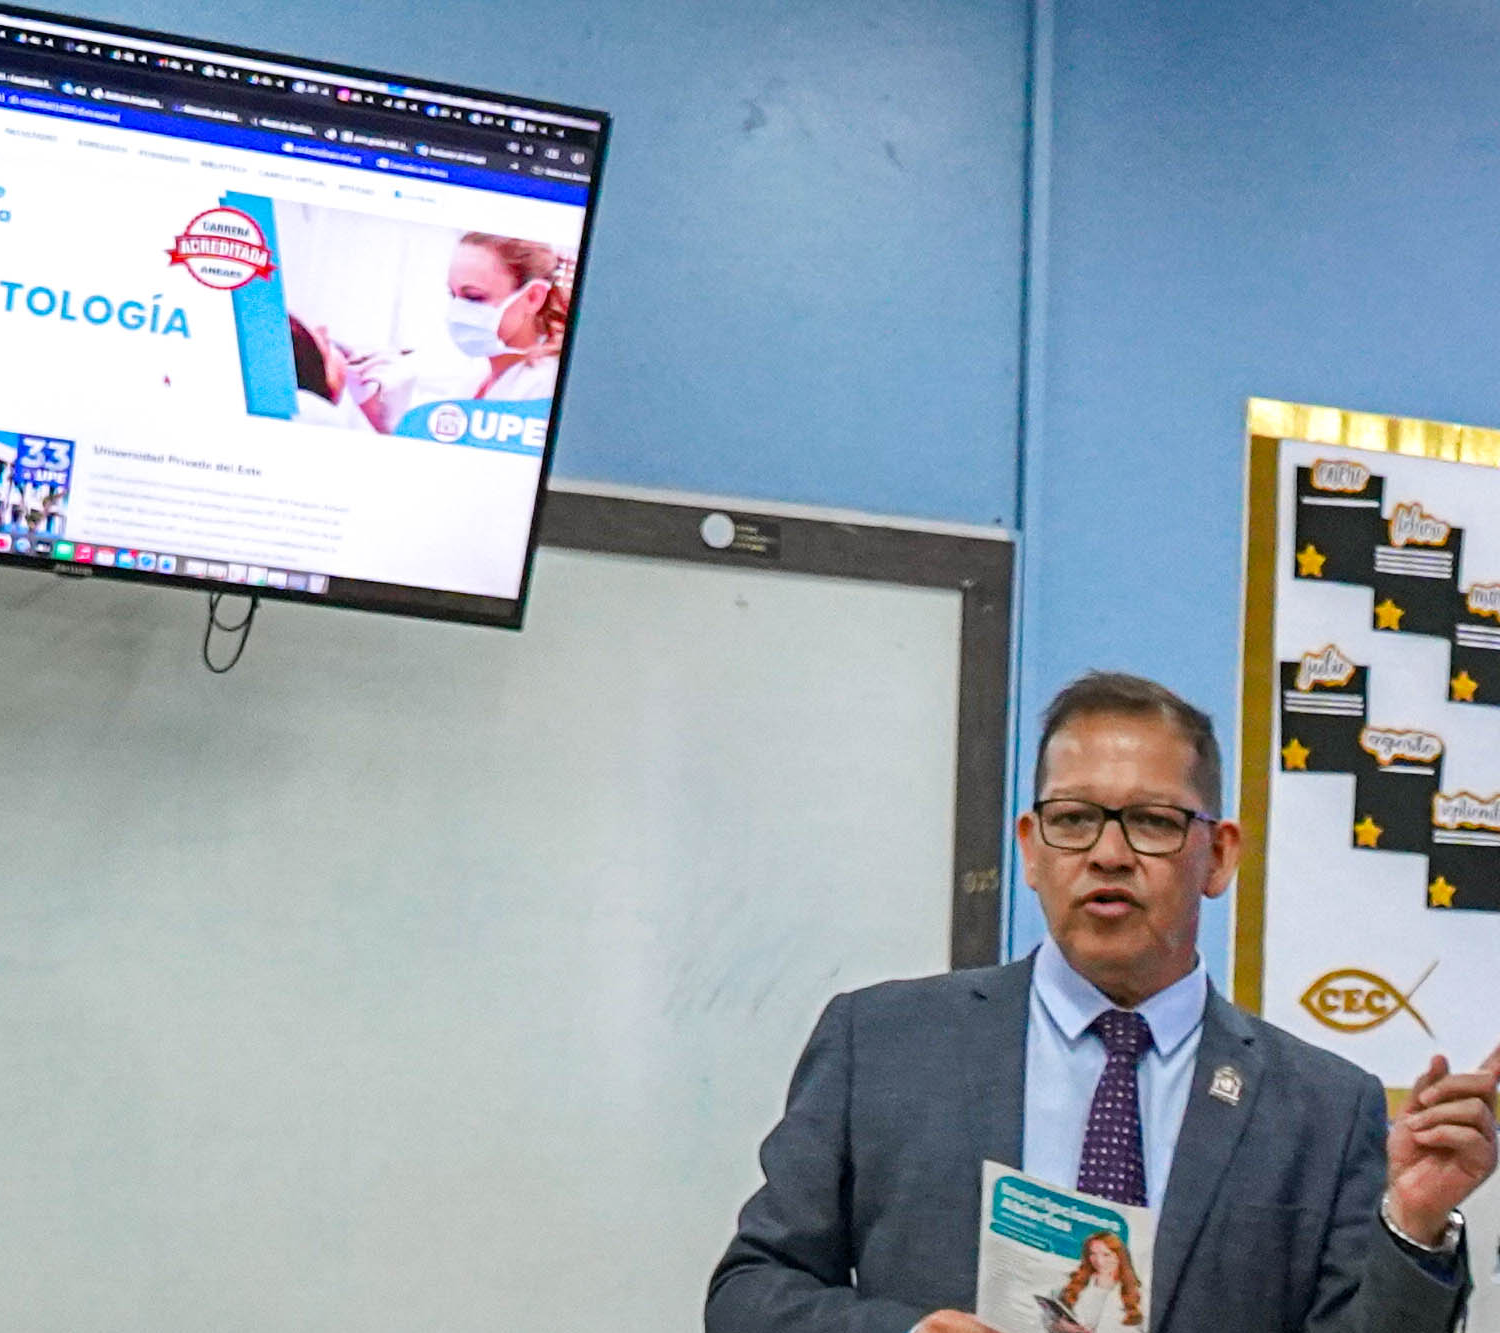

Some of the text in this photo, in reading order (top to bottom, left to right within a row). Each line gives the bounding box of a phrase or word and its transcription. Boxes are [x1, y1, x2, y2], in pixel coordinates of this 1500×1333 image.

[470, 409, 547, 447] UPE
[22, 437, 70, 470] 33
[1318, 988, 1386, 1015] CEC
